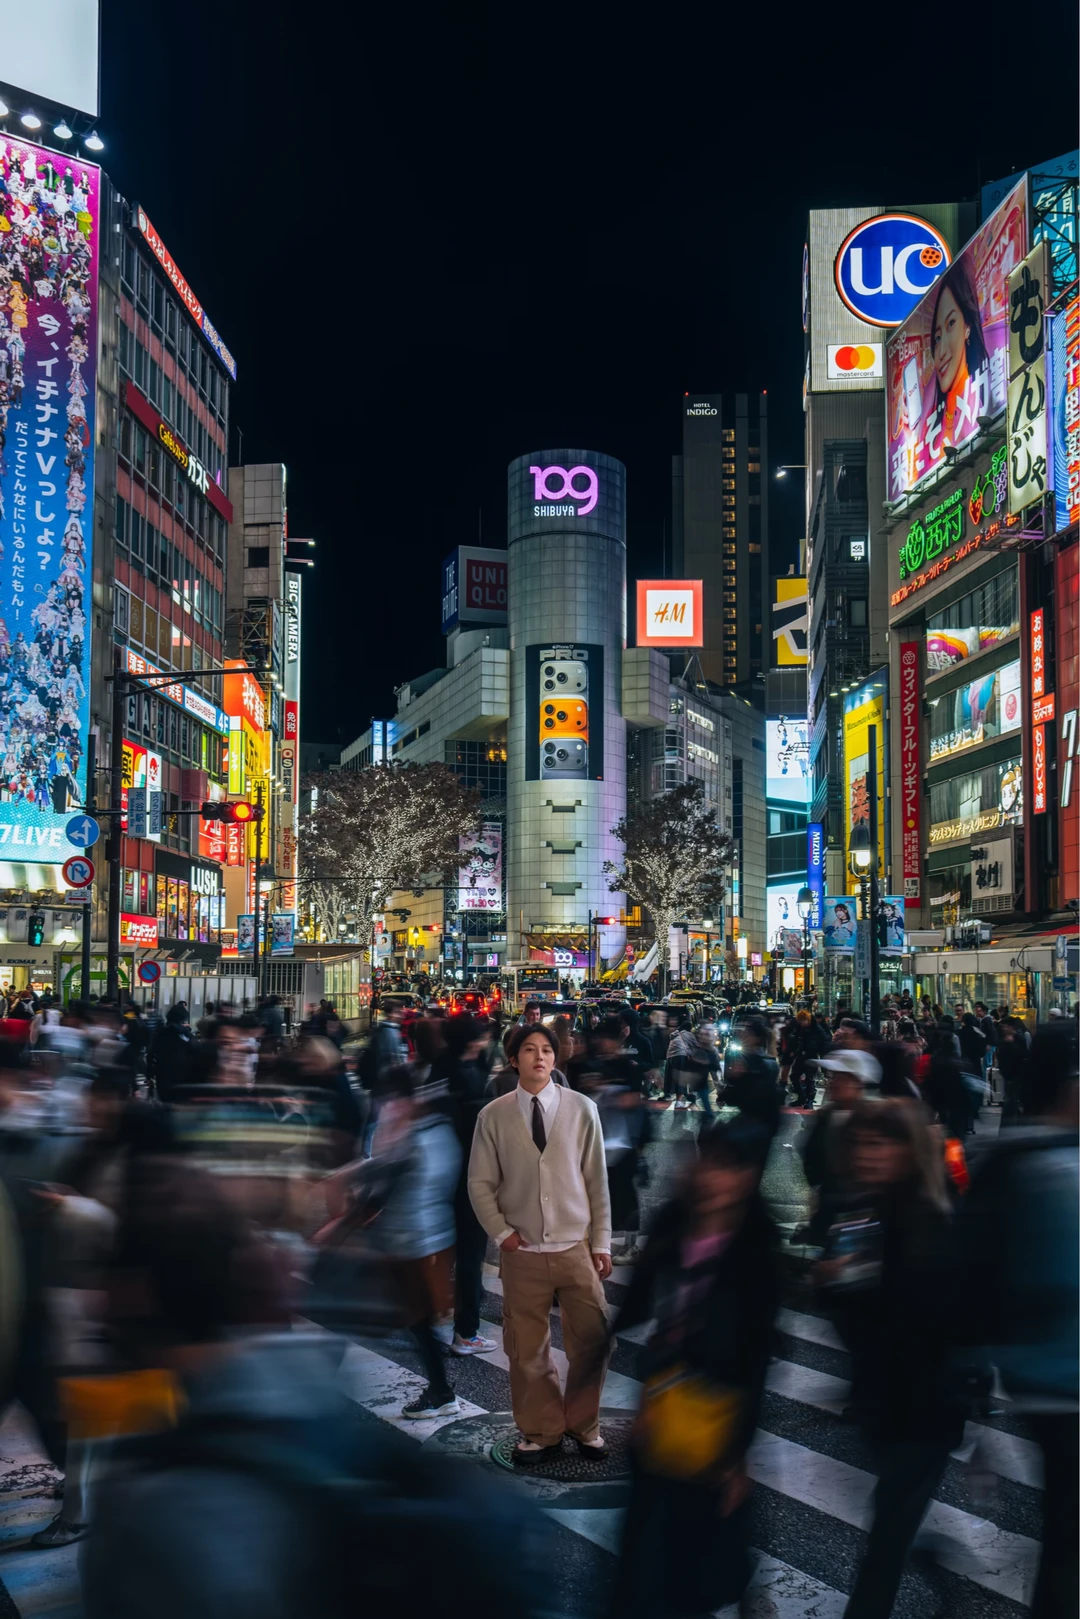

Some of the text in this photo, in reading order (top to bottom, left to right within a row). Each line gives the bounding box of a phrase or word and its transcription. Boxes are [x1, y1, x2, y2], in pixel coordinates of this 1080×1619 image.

[1010, 265, 1046, 490] もんじゃ
[188, 454, 209, 495] ガスト
[529, 465, 599, 516] 109
[534, 505, 575, 517] SHIBUYA
[926, 503, 962, 560] 西村
[472, 566, 504, 585] UNI
[472, 586, 507, 606] QLO
[288, 580, 298, 661] BIC CAMERA
[654, 603, 685, 624] H&M
[539, 649, 588, 661] PRO
[218, 712, 229, 733] 4F
[903, 667, 917, 817] ウィンターフルーツギフト
[136, 791, 144, 833] 渋谷駅前
[812, 831, 820, 866] MIZUHO
[191, 866, 218, 896] LUSH
[553, 952, 573, 966] 109
